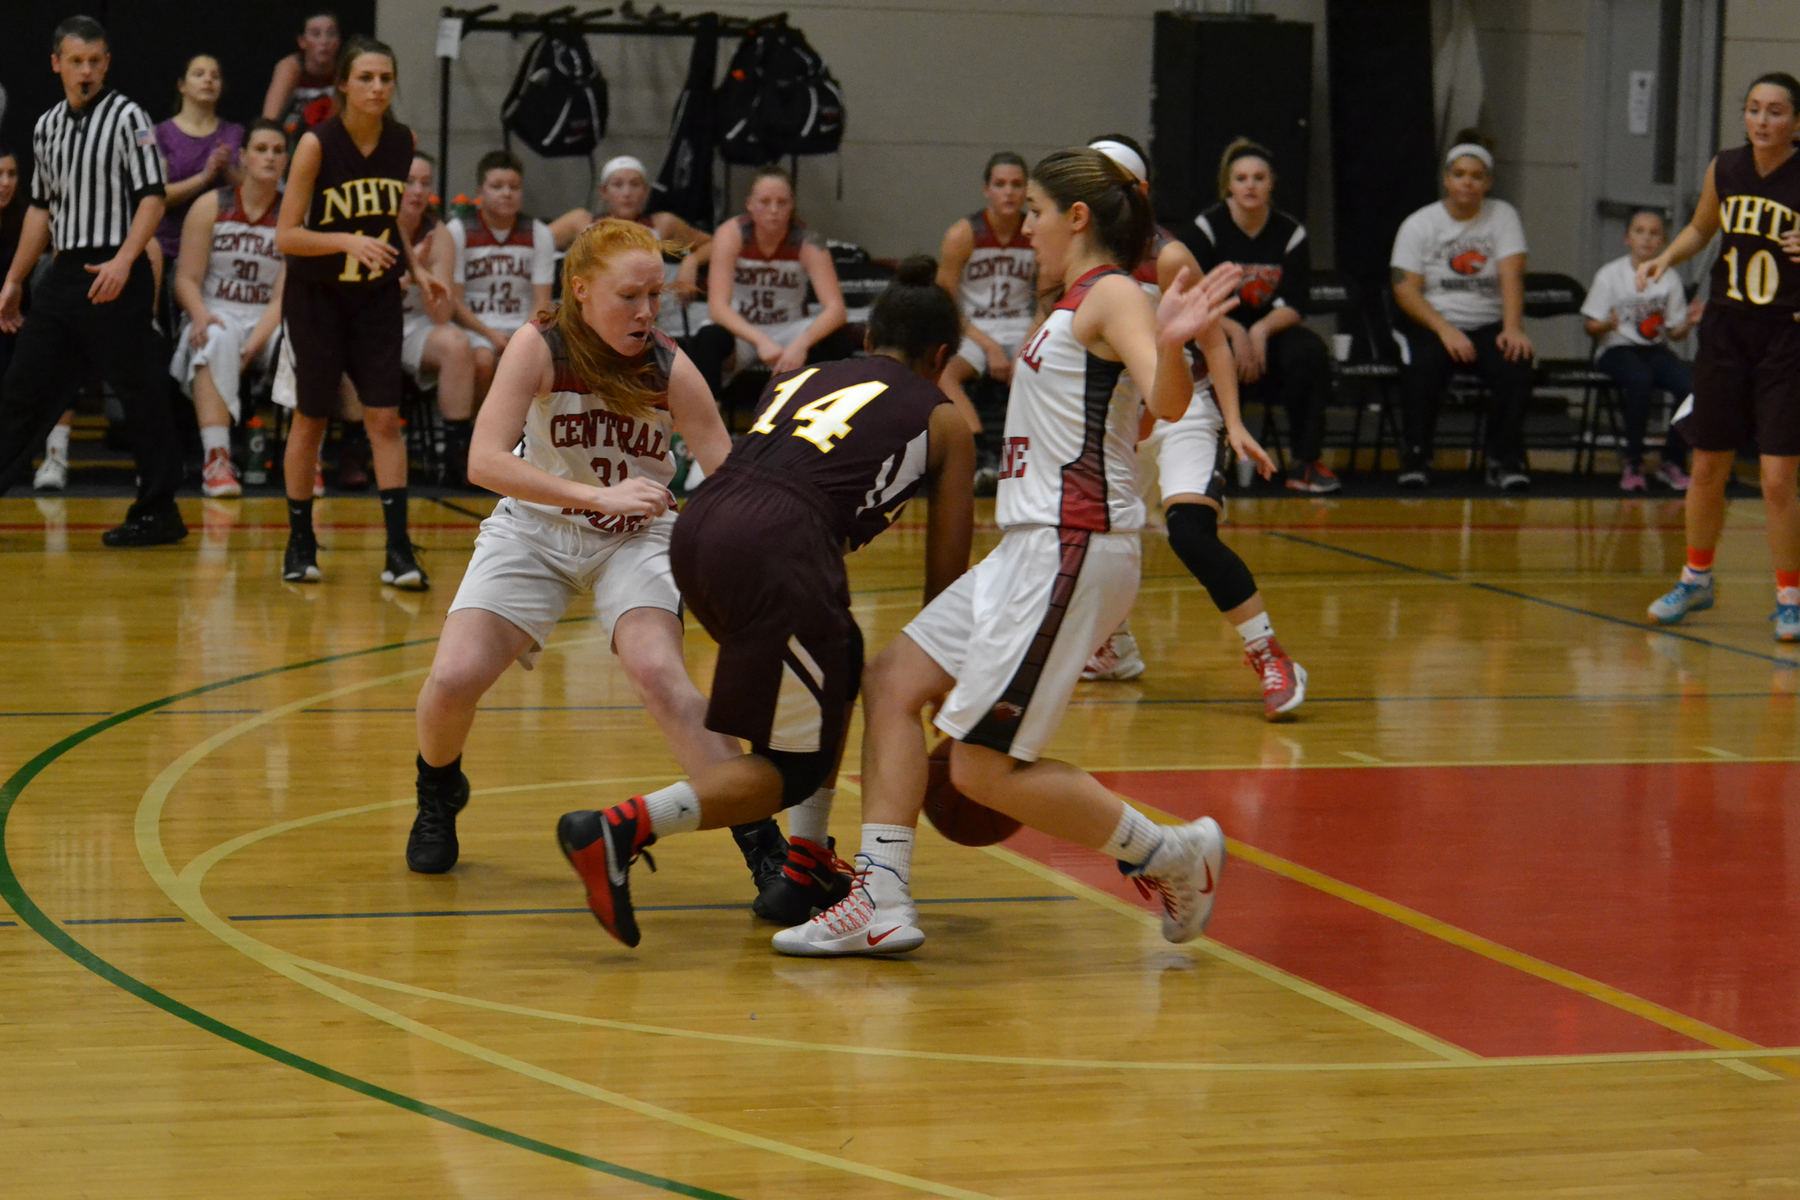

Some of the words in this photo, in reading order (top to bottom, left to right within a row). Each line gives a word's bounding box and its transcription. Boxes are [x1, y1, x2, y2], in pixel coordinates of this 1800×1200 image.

[233, 259, 259, 282] 30
[1723, 246, 1779, 305] 10
[215, 278, 272, 304] MAINE
[989, 283, 1011, 308] 12
[748, 368, 889, 454] 14
[550, 409, 667, 462] CENTRAL
